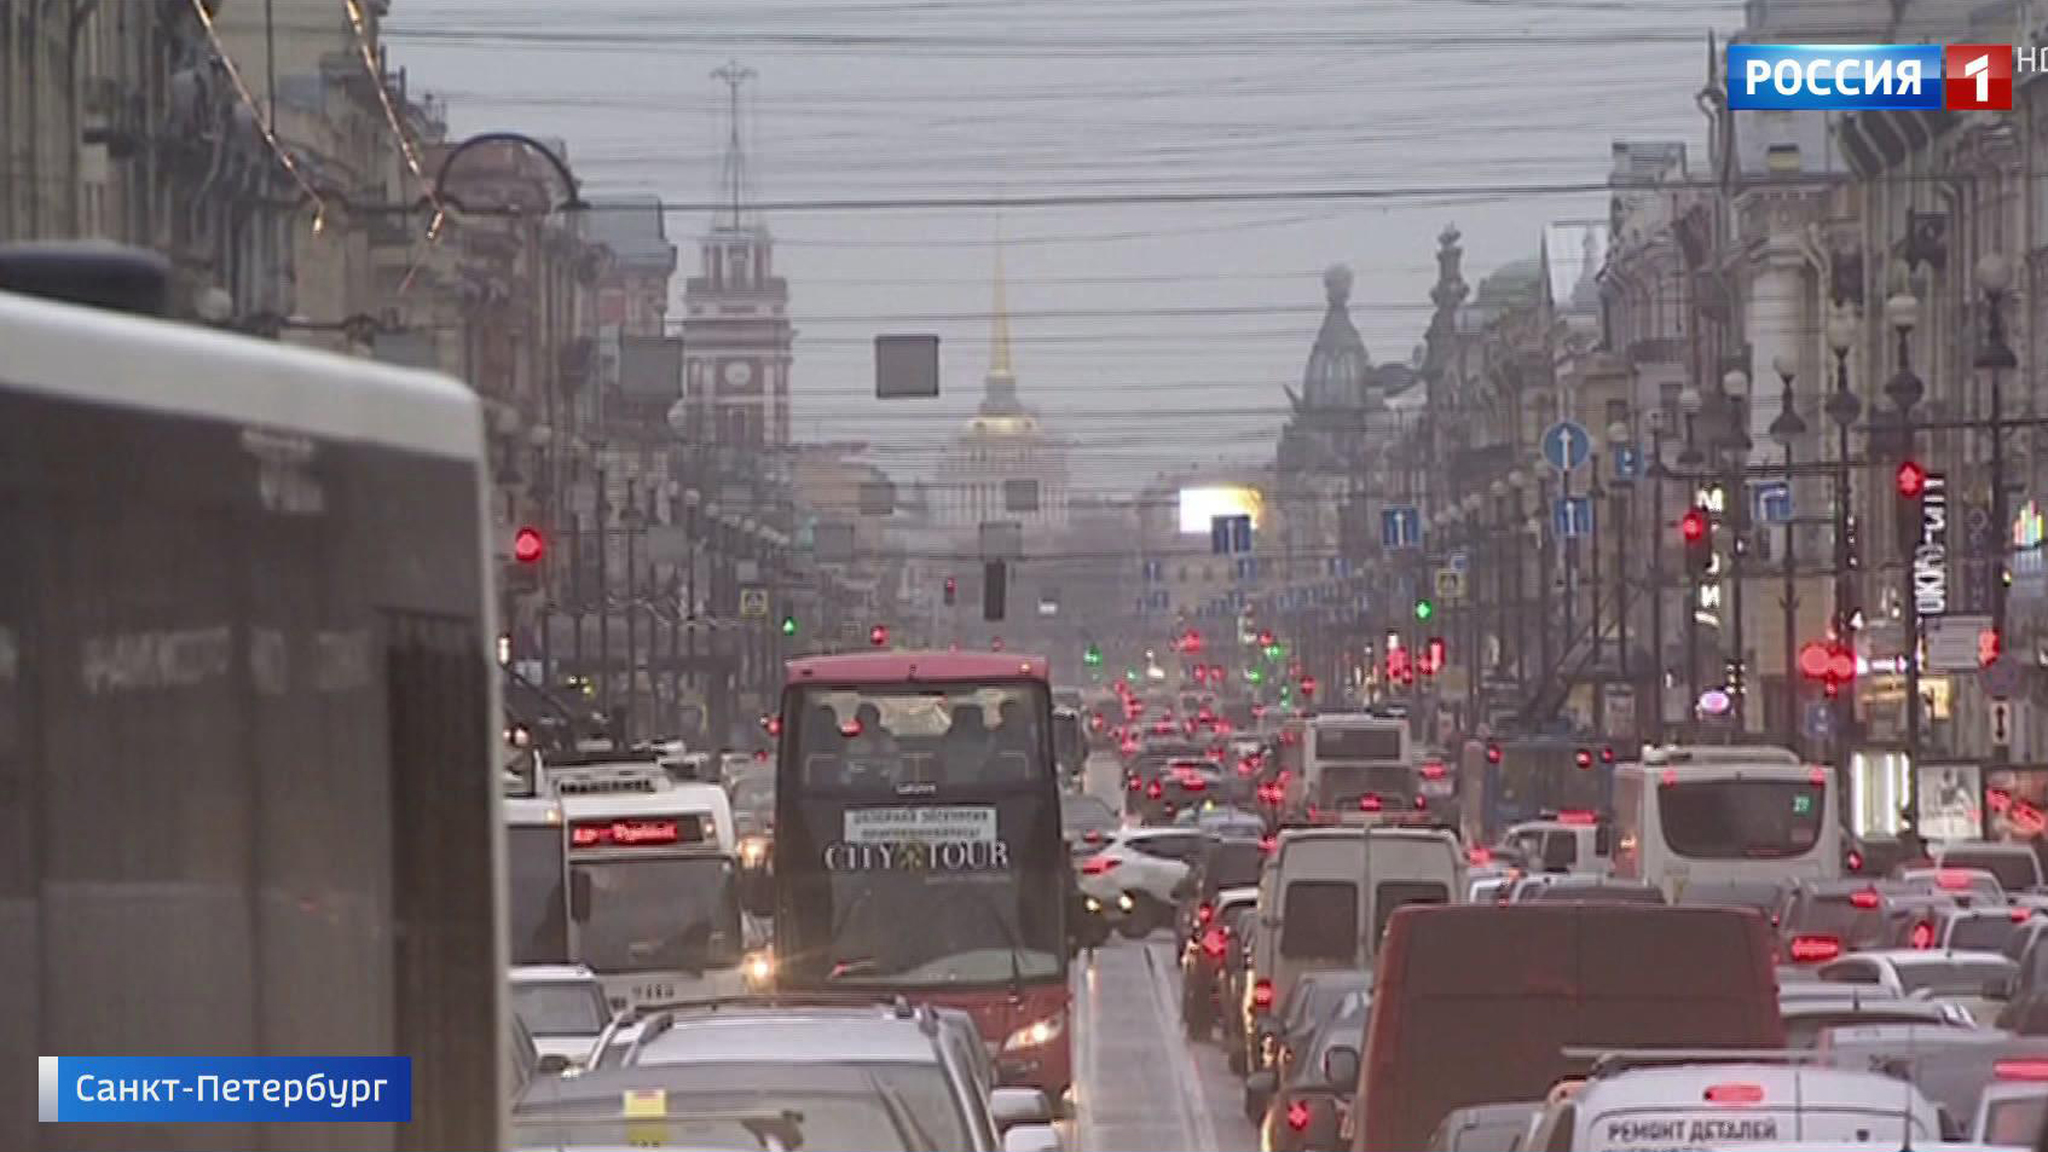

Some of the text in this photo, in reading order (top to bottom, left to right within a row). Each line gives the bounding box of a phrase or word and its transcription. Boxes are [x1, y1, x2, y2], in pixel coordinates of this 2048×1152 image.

[824, 842, 1008, 869] CITY TOUR
[1608, 1117, 1778, 1142] РЕМОНТ ДЕТАЛЕЙ
